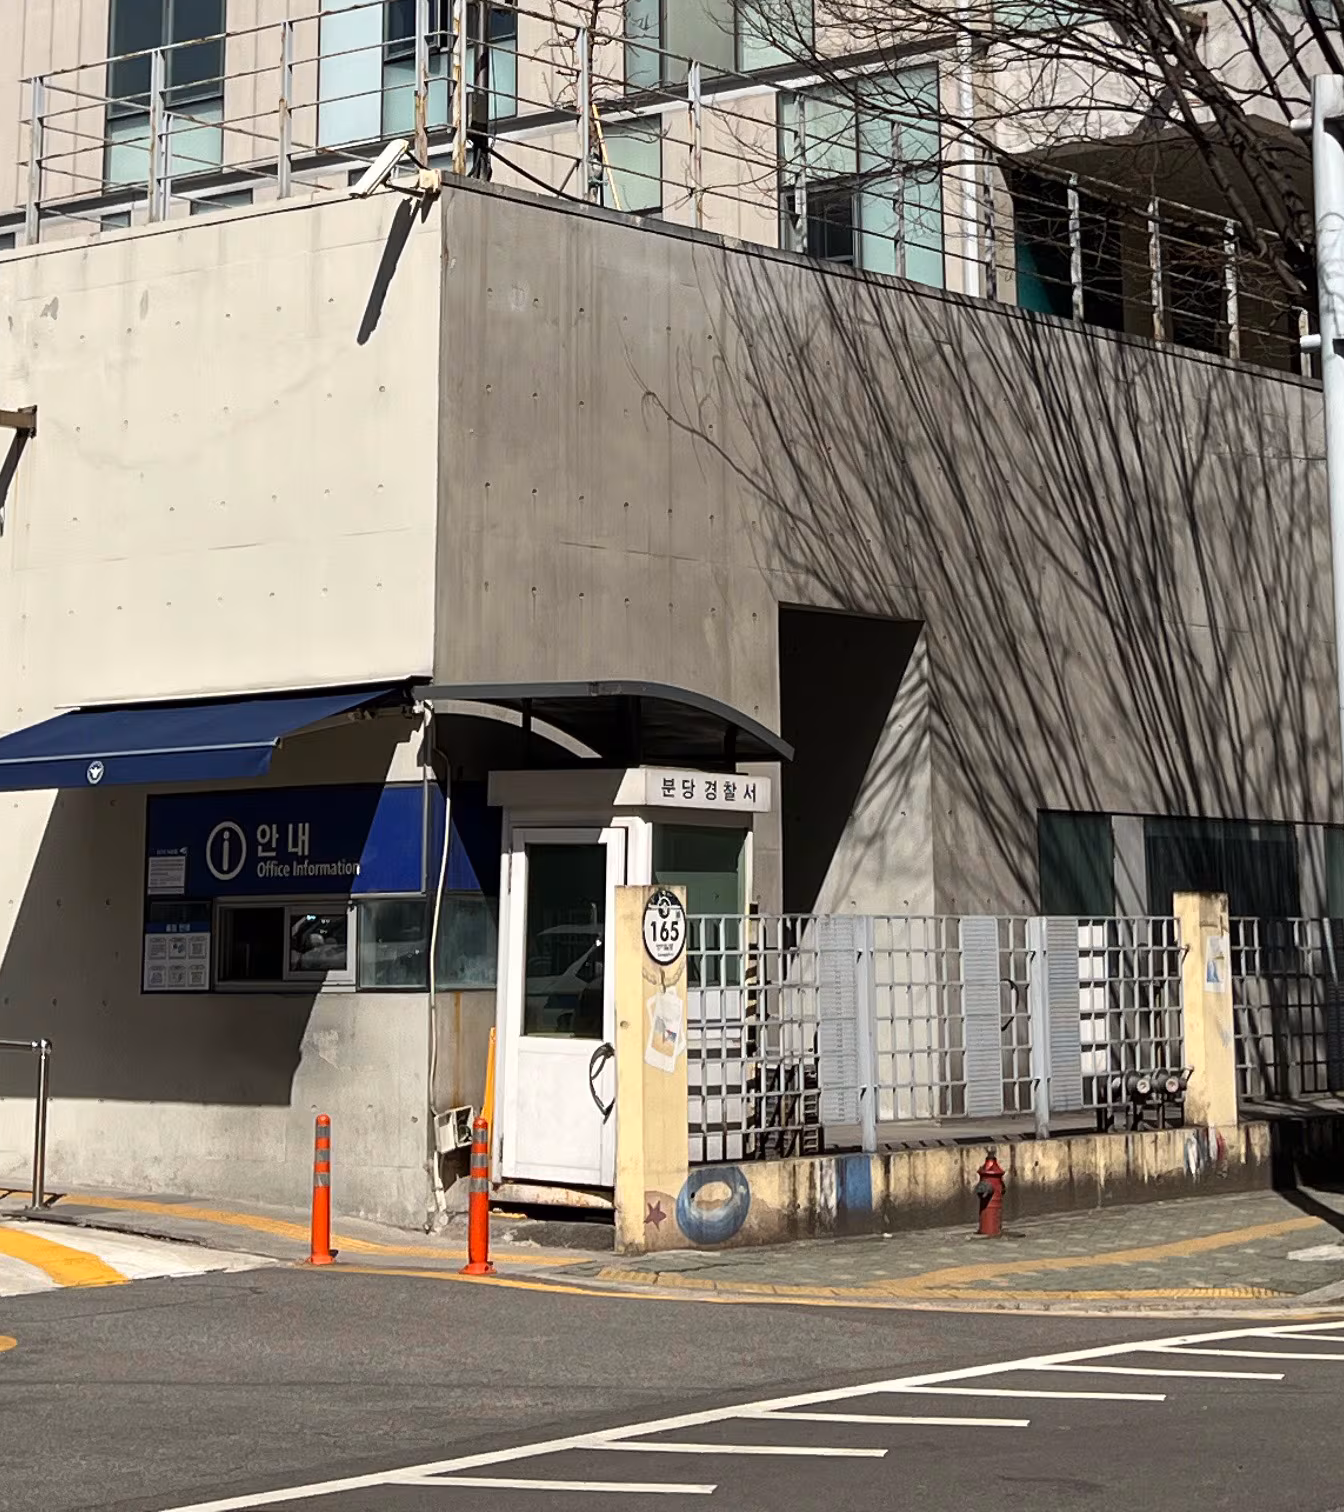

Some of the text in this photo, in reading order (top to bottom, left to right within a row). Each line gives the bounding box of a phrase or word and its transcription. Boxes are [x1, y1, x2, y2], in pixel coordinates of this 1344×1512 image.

[257, 859, 361, 878] Office Information
[651, 921, 679, 942] 165
